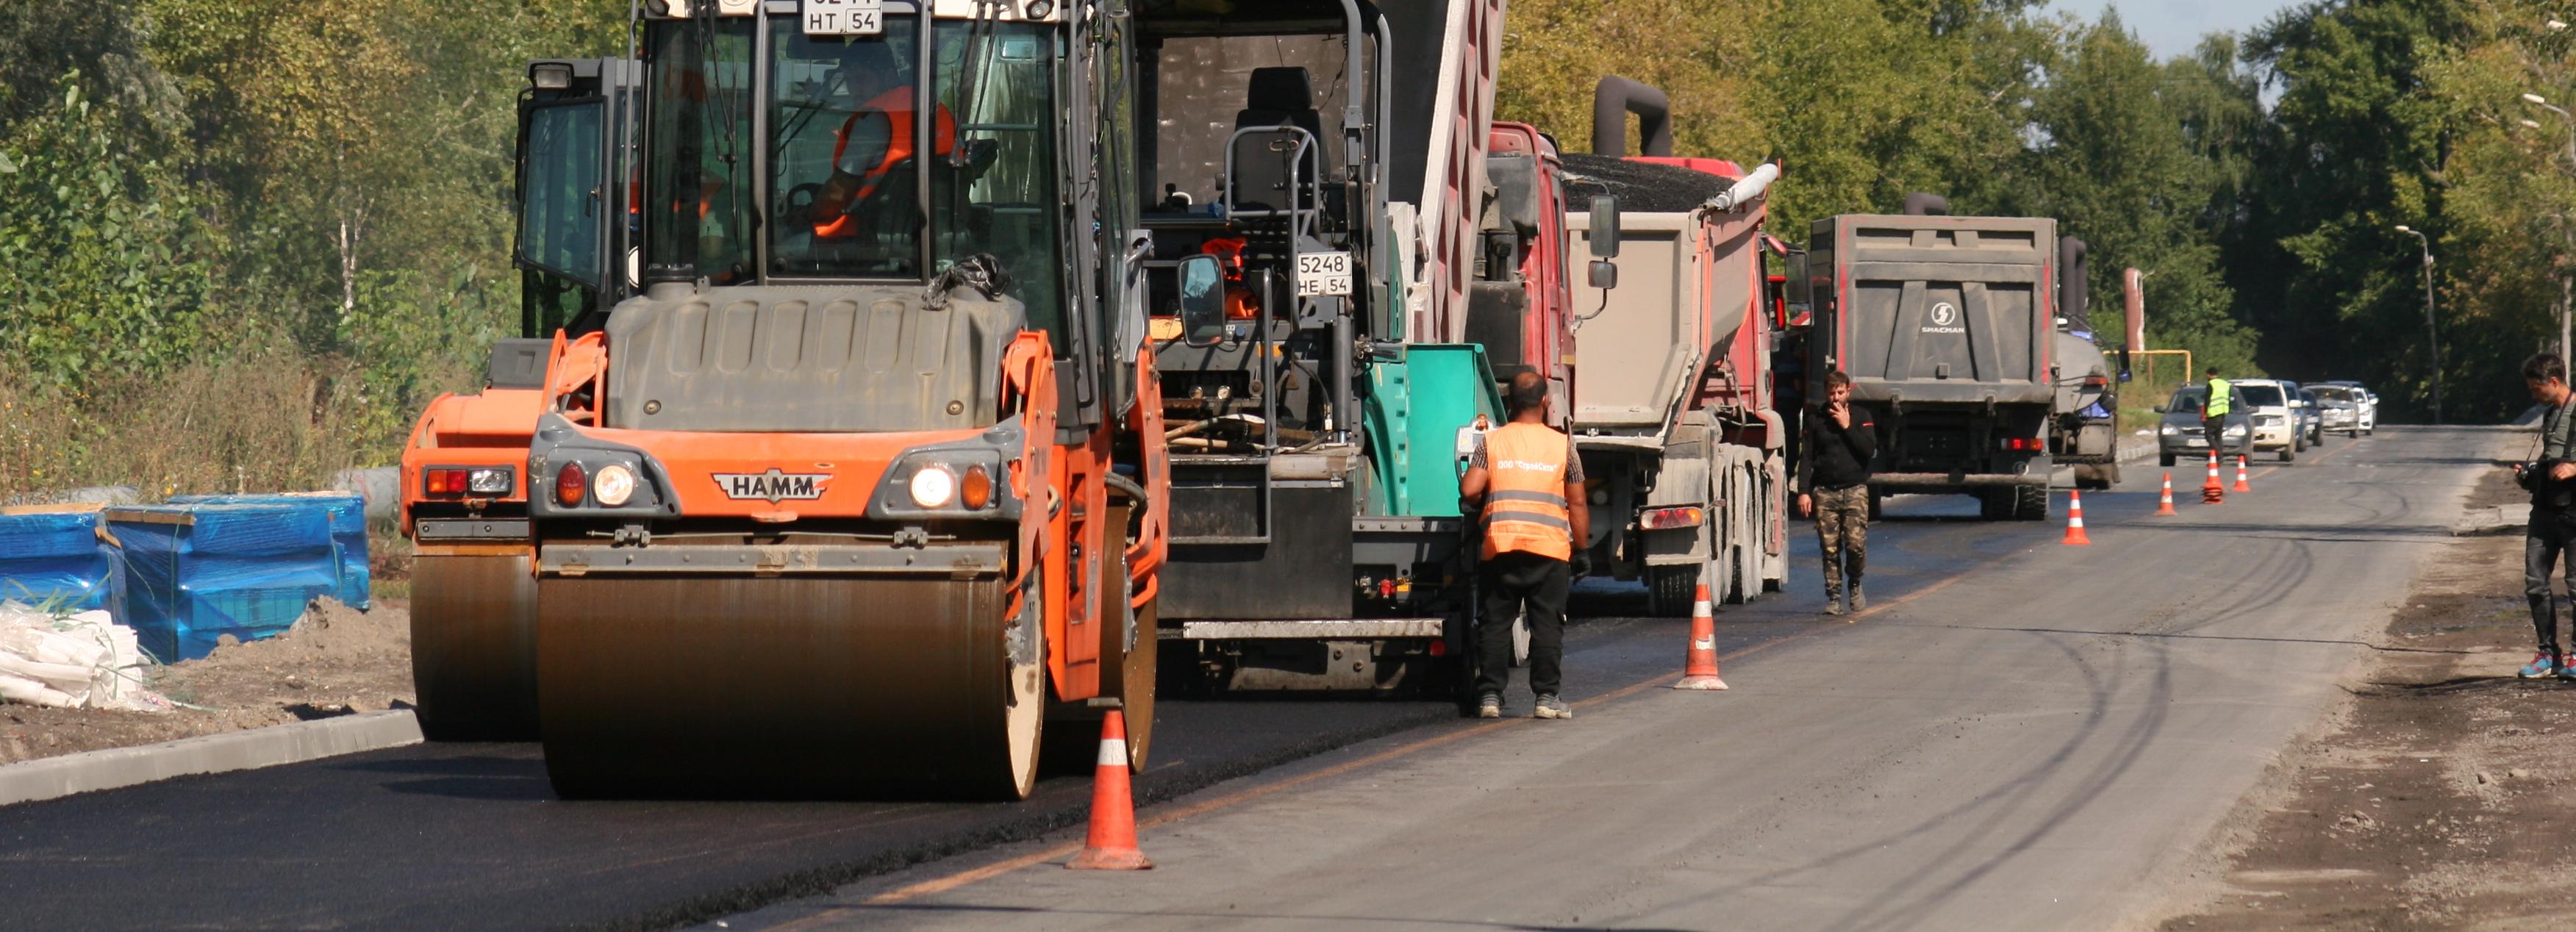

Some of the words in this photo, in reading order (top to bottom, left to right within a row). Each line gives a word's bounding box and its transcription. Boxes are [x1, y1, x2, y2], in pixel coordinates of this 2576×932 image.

[810, 13, 837, 29] НТ
[853, 13, 874, 29] 54
[1300, 256, 1344, 273] 5248
[1298, 280, 1318, 293] НЕ
[1330, 279, 1346, 291] 54
[733, 477, 814, 495] HAMM
